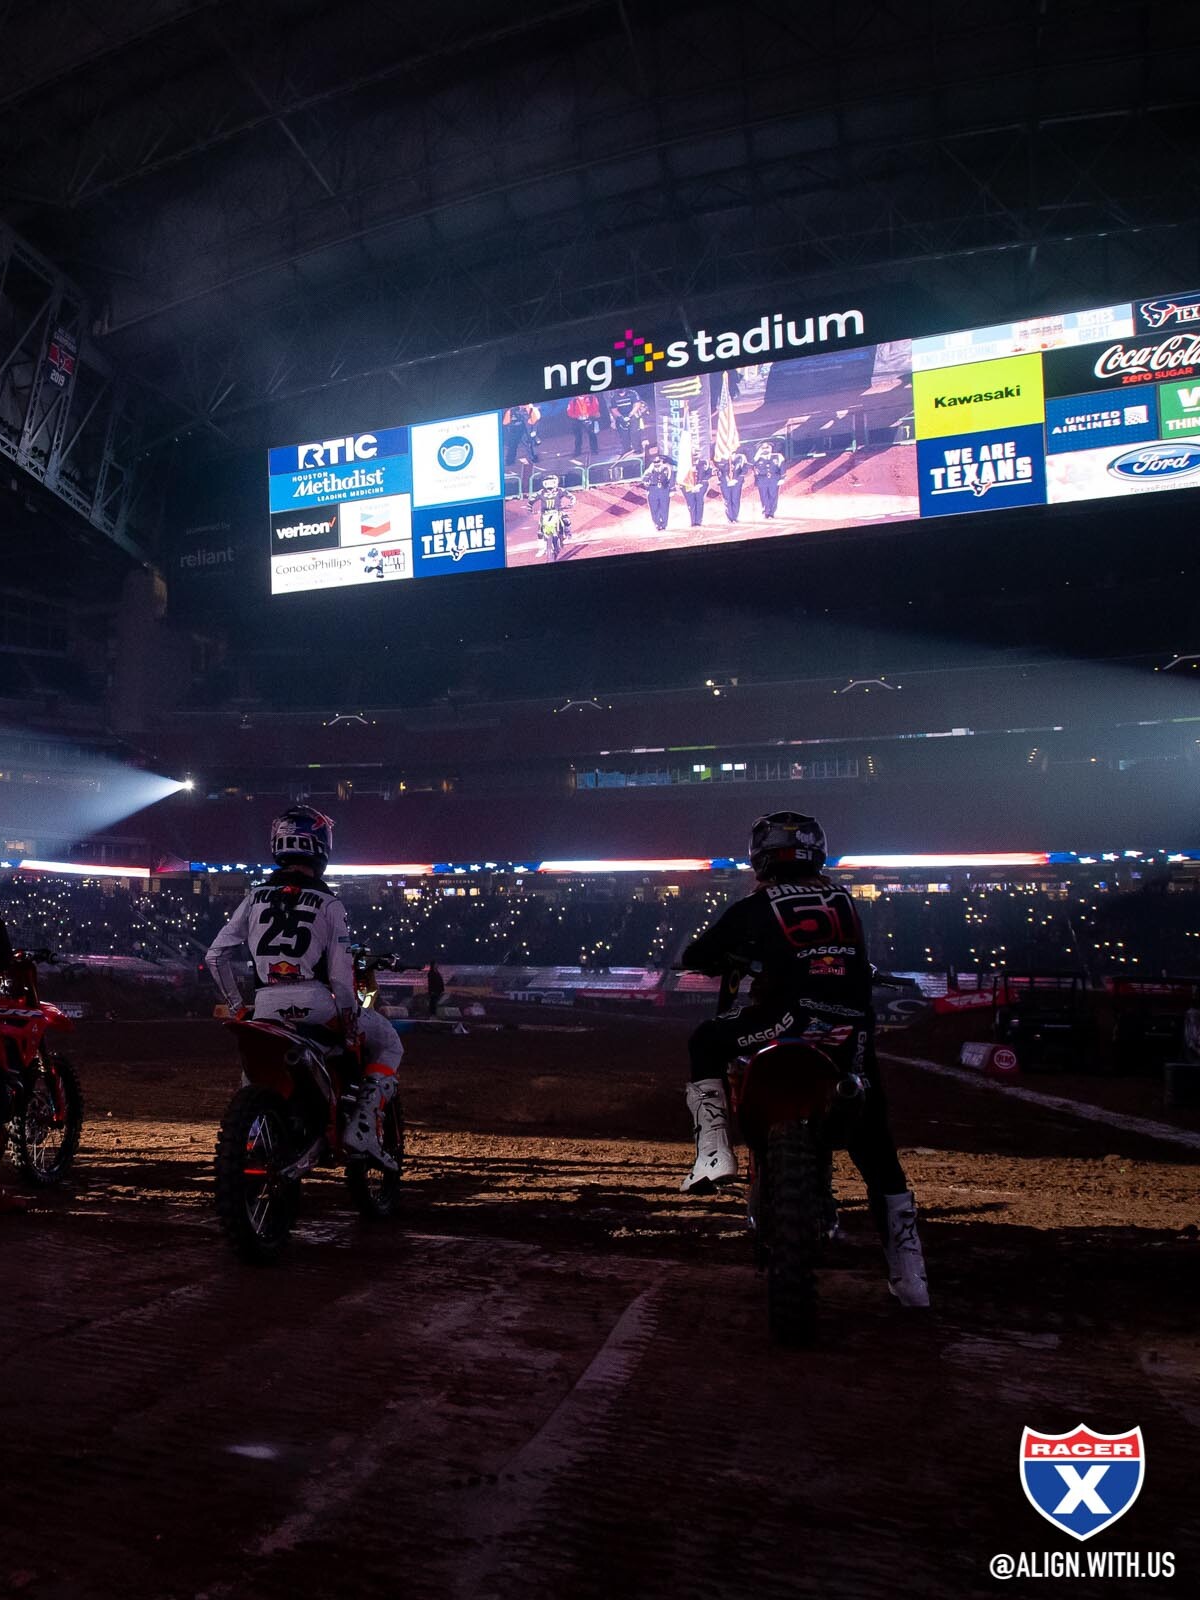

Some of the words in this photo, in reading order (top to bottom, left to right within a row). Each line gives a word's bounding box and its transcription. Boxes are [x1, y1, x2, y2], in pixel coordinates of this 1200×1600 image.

[543, 355, 613, 392] nrg
[666, 309, 864, 368] stadium
[1122, 373, 1152, 384] zero
[1155, 367, 1193, 379] SUGAR
[934, 385, 1021, 408] Kawasaki
[1052, 418, 1121, 435] AIRLINES
[1065, 411, 1120, 424] UNITED
[298, 435, 378, 469] RTIC
[944, 447, 973, 466] WE
[980, 441, 1016, 461] ARE
[1132, 450, 1191, 474] Ford
[292, 472, 328, 482] HOUSTON
[292, 468, 384, 497] Methodist
[930, 457, 1032, 489] TEXANS
[317, 493, 347, 502] LEADING
[350, 487, 384, 497] MEDICINE
[276, 521, 331, 540] verizon
[432, 519, 453, 534] WE
[458, 514, 484, 530] ARE
[421, 527, 496, 555] TEXANS
[180, 546, 235, 568] reliant
[275, 556, 352, 576] ConocoPhillips
[770, 891, 858, 949] 51
[256, 907, 317, 958] 25
[797, 945, 857, 960] GASGAS
[737, 1011, 794, 1048] GASGAS
